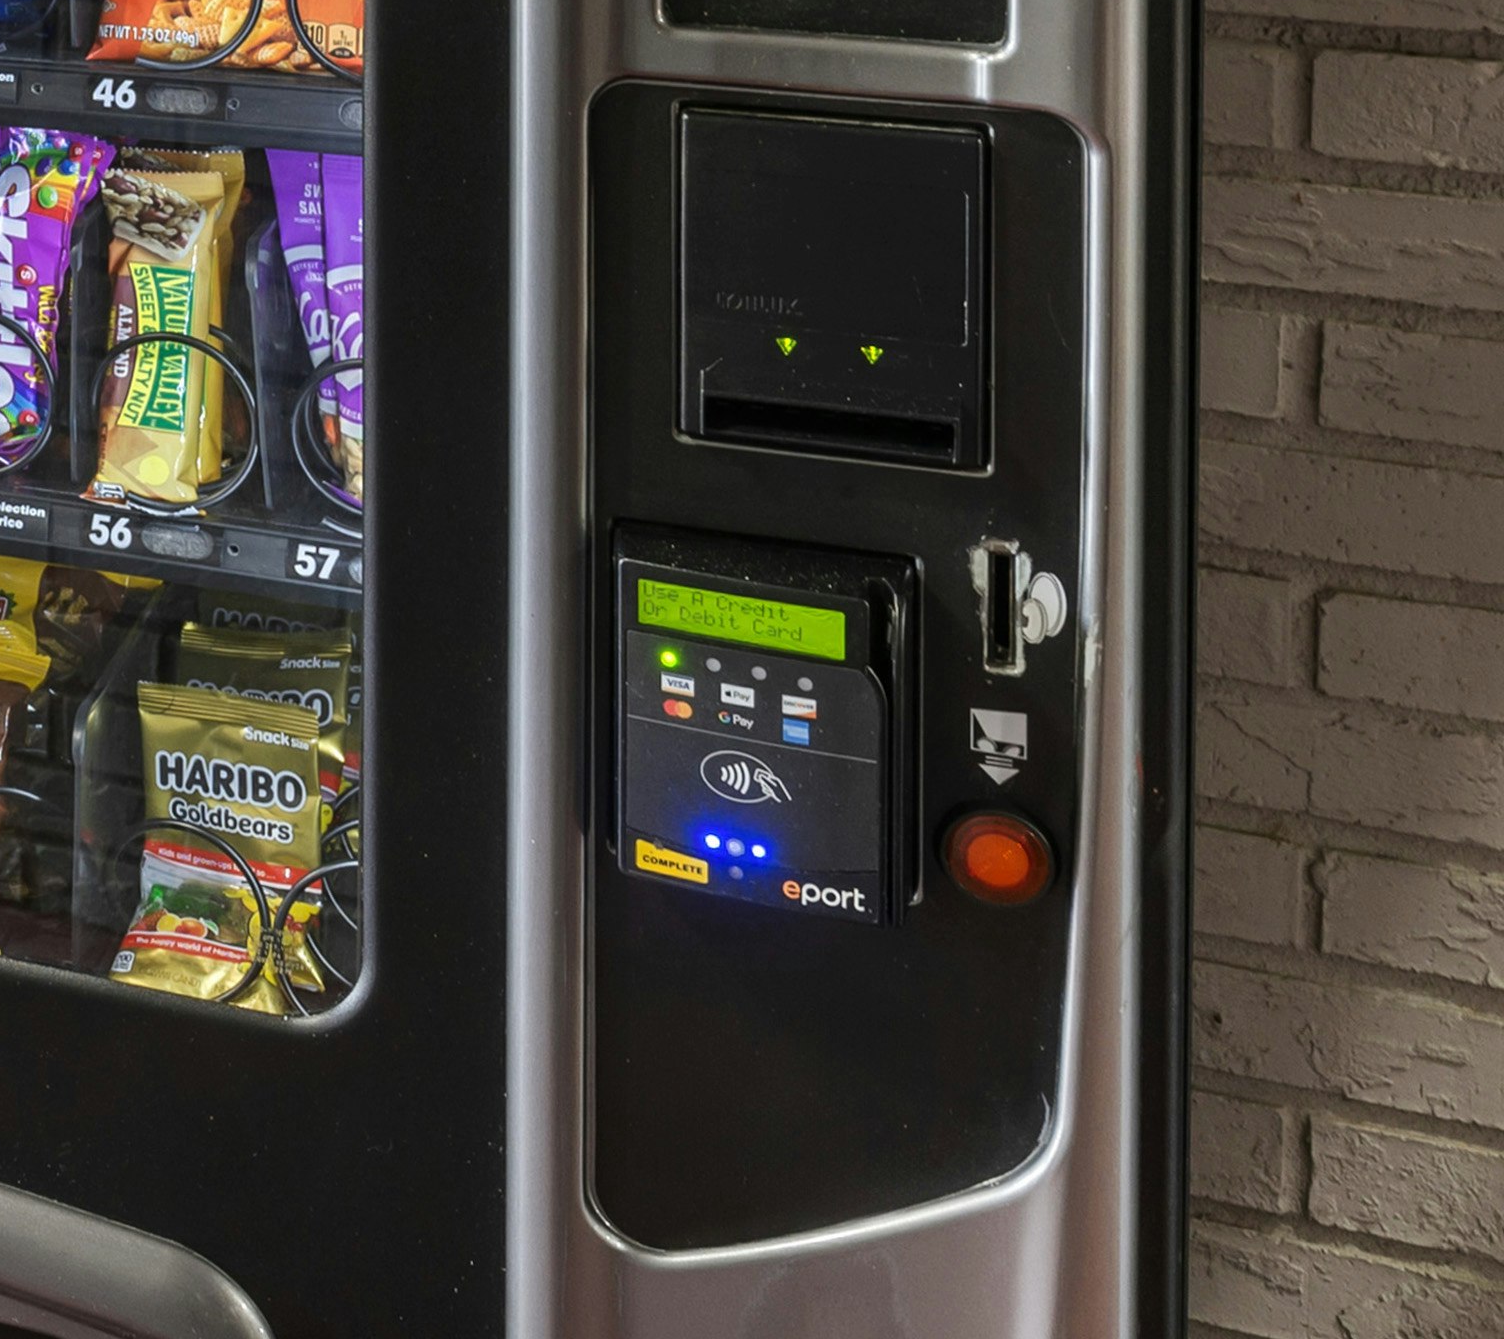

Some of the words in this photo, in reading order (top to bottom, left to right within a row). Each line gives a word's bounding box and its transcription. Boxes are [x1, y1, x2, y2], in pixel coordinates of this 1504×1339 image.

[93, 79, 137, 108] 46
[88, 515, 132, 548] 56
[295, 546, 340, 579] 57
[643, 582, 679, 602] Use
[692, 591, 704, 605] A
[716, 596, 790, 621] Credit
[643, 600, 667, 617] Or
[680, 607, 738, 630] Debit
[753, 619, 802, 642] Card
[667, 678, 690, 690] VISA
[244, 725, 289, 747] Snack
[290, 737, 310, 751] Size
[155, 750, 307, 812] HARIBO
[169, 797, 294, 843] Goldbears
[643, 853, 703, 875] COMPLETE
[782, 880, 865, 912] eport
